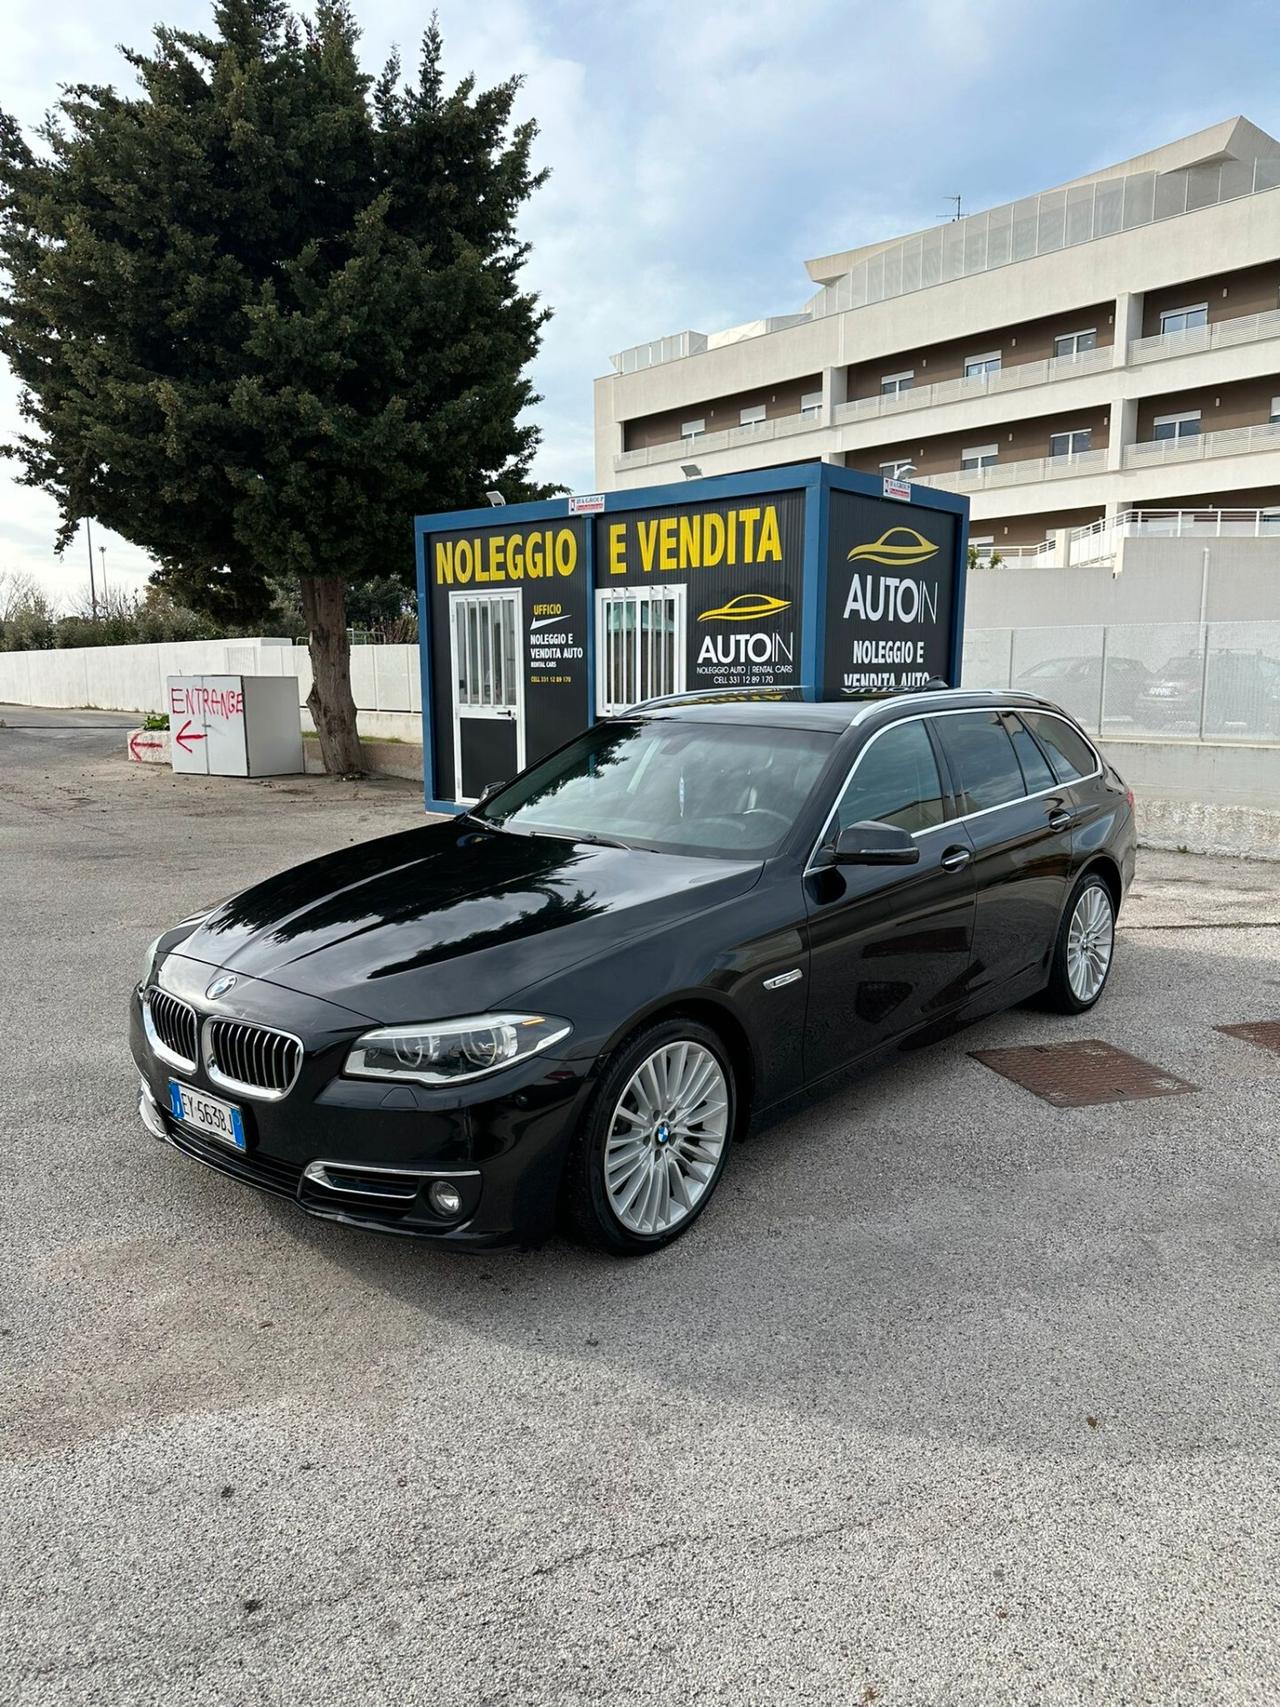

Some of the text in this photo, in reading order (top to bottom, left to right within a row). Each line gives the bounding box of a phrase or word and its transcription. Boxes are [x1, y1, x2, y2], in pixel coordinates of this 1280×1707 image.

[436, 505, 782, 585] NOLEGGIO E VENDITA
[533, 603, 562, 616] UFFICIO
[530, 633, 574, 645] NOLEGGIO E
[530, 647, 583, 659] VENDITA AUTO
[853, 640, 924, 664] NOLEGGIO E
[696, 666, 729, 674] NOLEGGIO
[752, 665, 774, 673] RENTAL
[775, 665, 793, 673] CARS
[713, 676, 728, 684] CELL
[728, 676, 741, 684] 331
[751, 675, 760, 683] 89
[761, 675, 774, 683] 170
